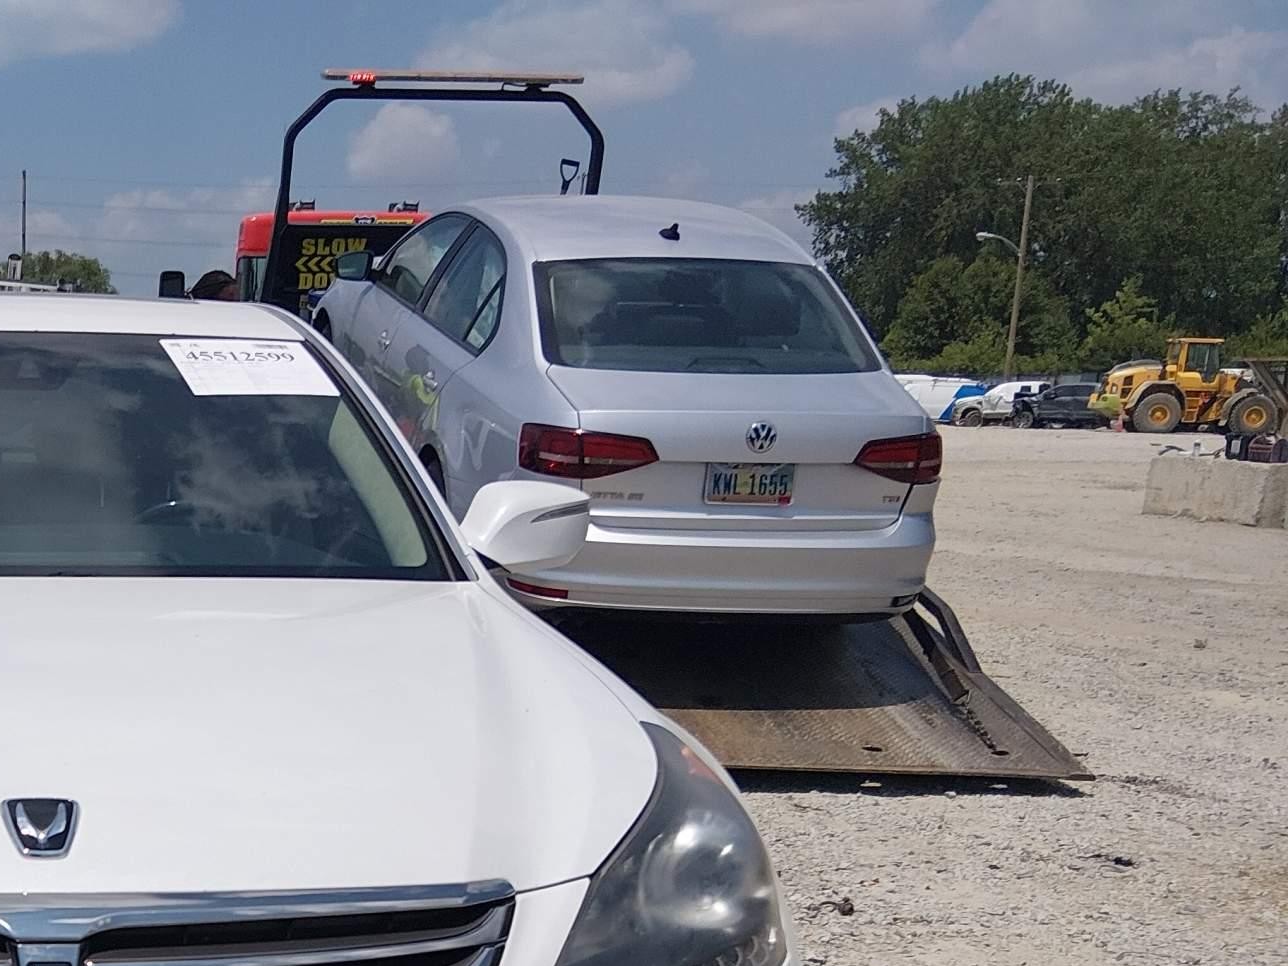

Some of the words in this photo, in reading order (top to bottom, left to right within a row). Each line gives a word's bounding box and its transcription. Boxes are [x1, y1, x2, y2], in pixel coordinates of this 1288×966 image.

[302, 238, 368, 256] SLOW
[297, 272, 335, 290] DO
[186, 351, 295, 362] 45512599
[748, 473, 788, 496] 1655
